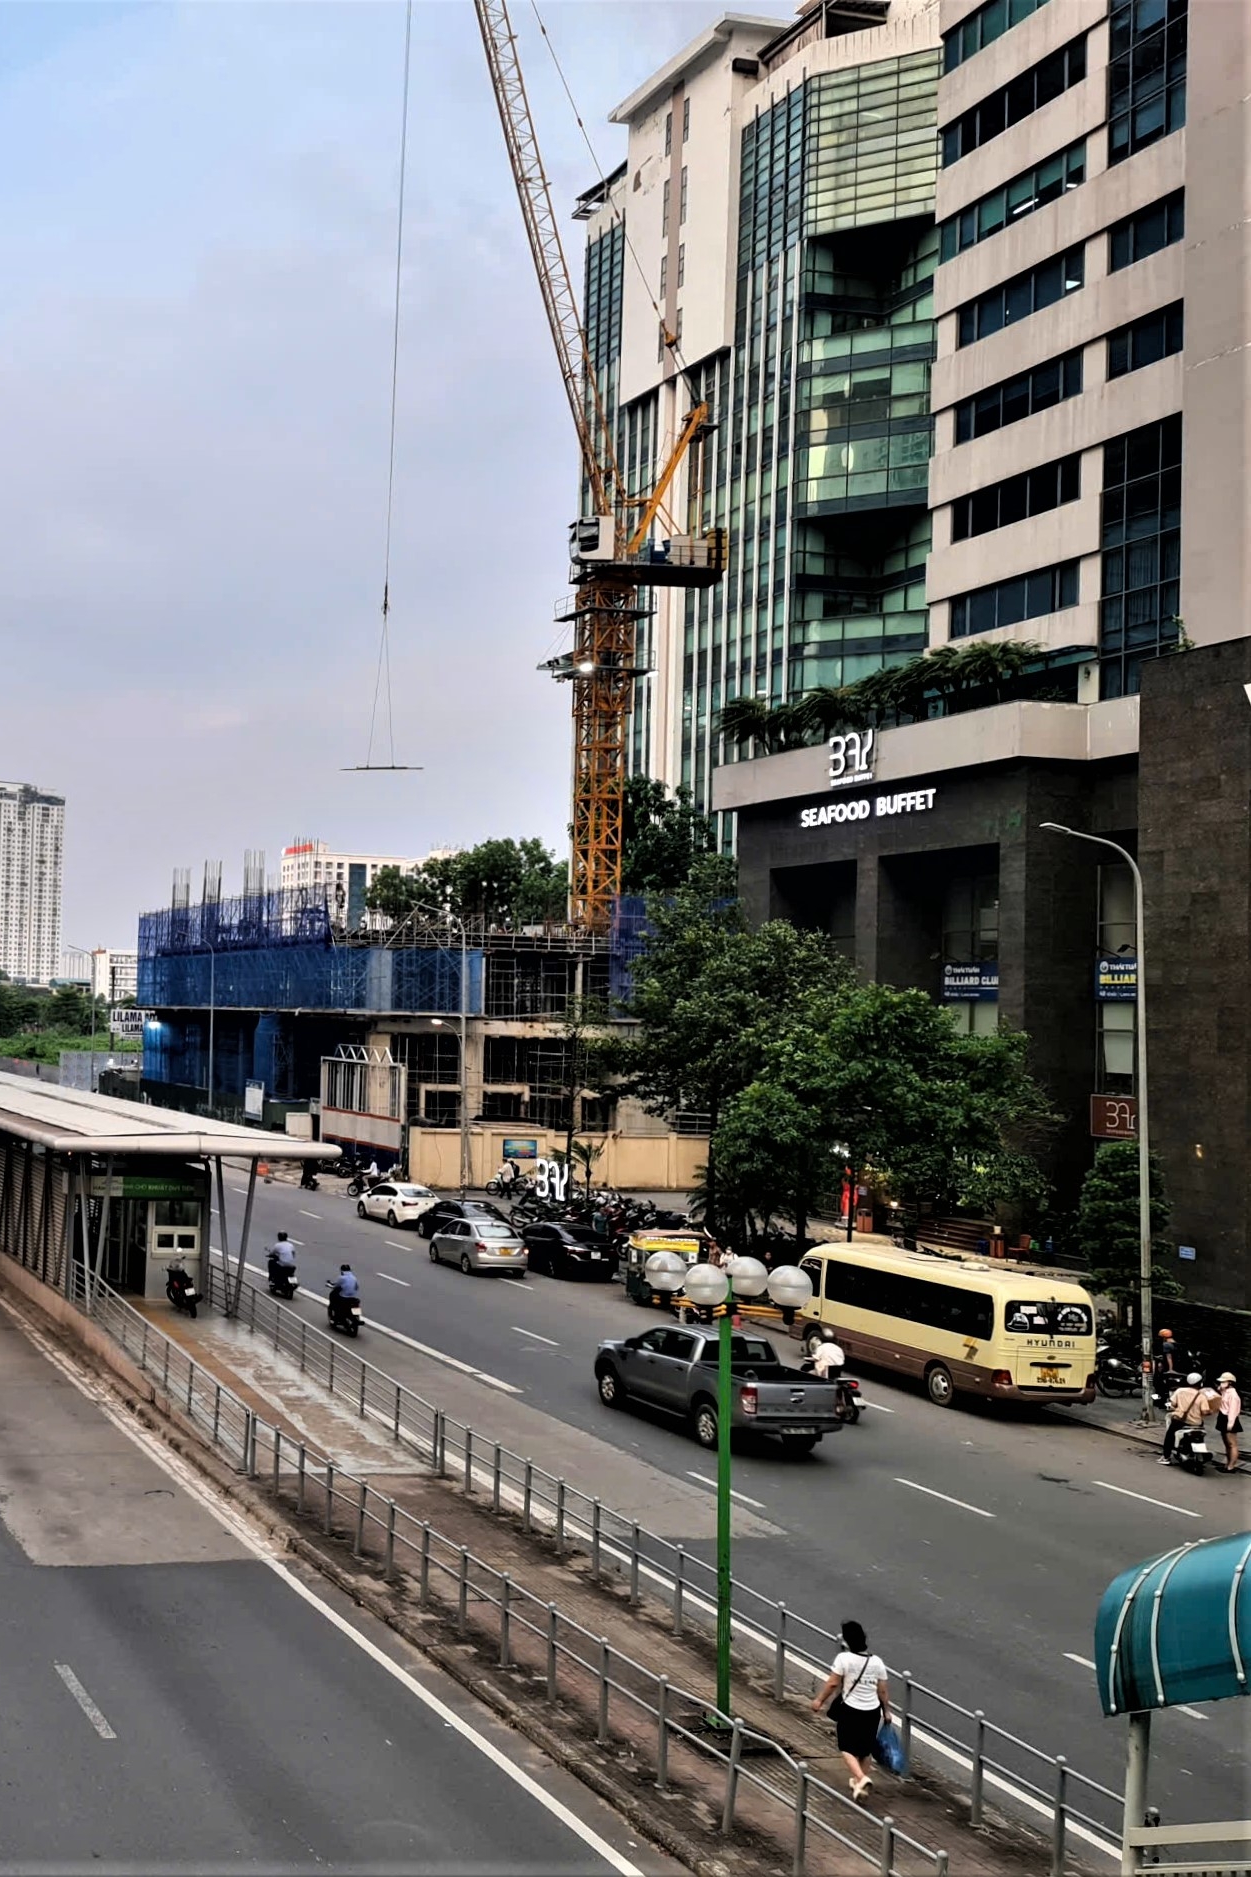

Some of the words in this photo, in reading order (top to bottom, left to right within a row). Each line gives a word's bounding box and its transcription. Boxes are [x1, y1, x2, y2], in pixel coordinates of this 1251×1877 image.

[829, 729, 873, 776] BAY
[801, 800, 870, 827] SEAFOOD
[875, 788, 936, 816] BUFFET
[944, 976, 980, 985] BILLIARD
[1099, 974, 1137, 984] BILLIAR
[113, 1011, 142, 1022] LILAMA
[122, 1024, 143, 1032] LILAMA
[536, 1158, 569, 1201] BAY
[1027, 1339, 1075, 1348] HYUNDAI
